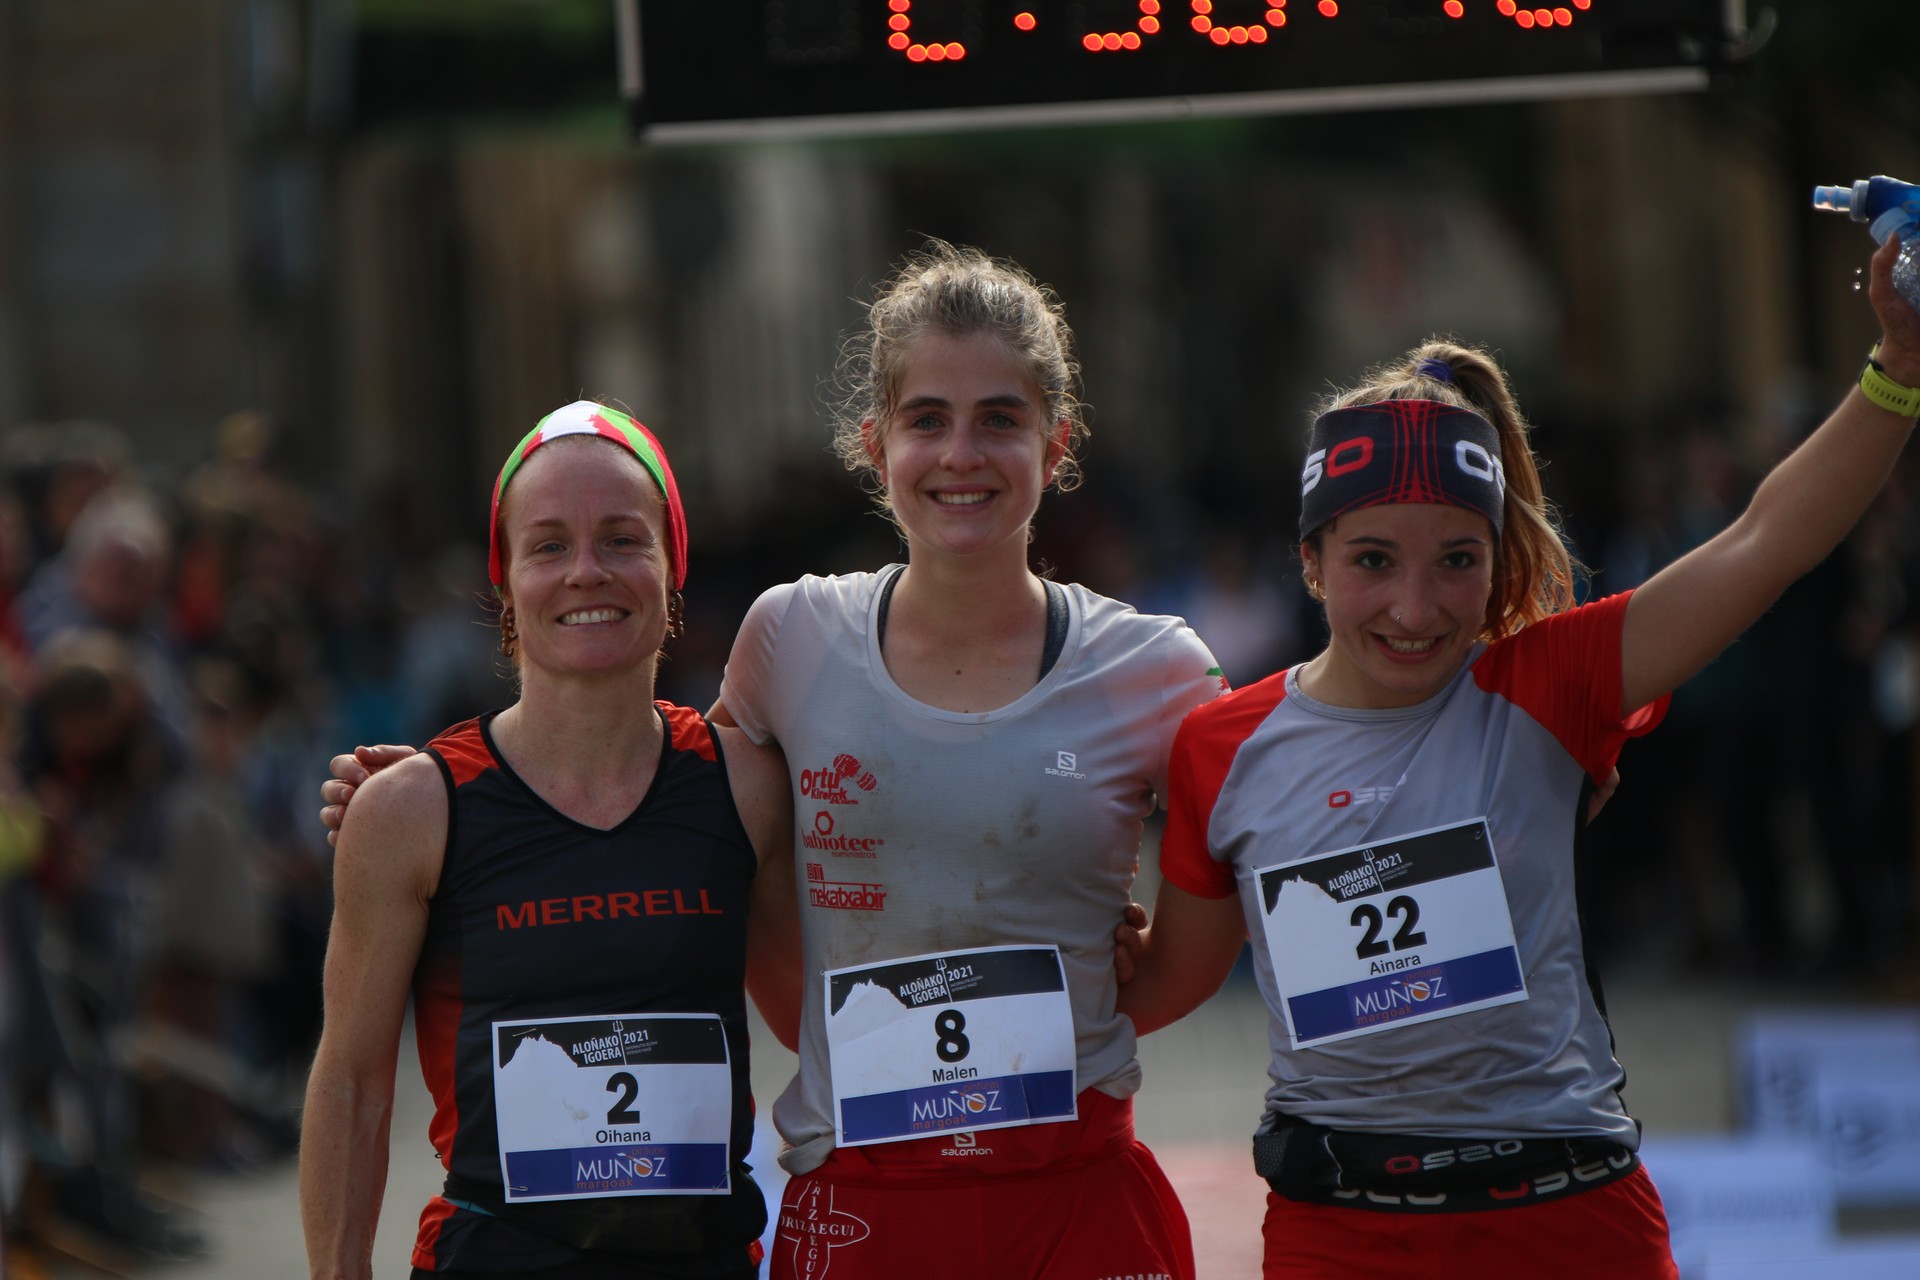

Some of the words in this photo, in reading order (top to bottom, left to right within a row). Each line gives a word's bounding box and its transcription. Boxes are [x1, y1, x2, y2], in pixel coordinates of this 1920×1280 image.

[800, 767, 841, 796] Ortu
[831, 851, 878, 859] suministros
[1328, 864, 1373, 892] ALOÑAKO
[1376, 853, 1404, 873] 2021
[1340, 876, 1378, 899] IGOERA
[496, 889, 724, 931] MERRELL
[1351, 895, 1428, 960] 22
[1370, 954, 1422, 975] Ainara
[1405, 966, 1442, 982] pinturas
[900, 973, 944, 998] ALOÑAKO
[947, 965, 974, 982] 2021
[911, 986, 948, 1006] IGOERA
[1355, 976, 1447, 1016] MUÑOZ
[1357, 1005, 1414, 1025] margoak
[572, 1035, 620, 1056] ALOÑAKO
[624, 1029, 649, 1045] 2021
[935, 1009, 971, 1063] 8
[584, 1047, 622, 1065] IGOERA
[932, 1067, 978, 1083] Malen
[963, 1081, 1000, 1093] pinturas
[606, 1072, 640, 1125] 2
[912, 1090, 1002, 1123] MUÑOZ
[913, 1115, 968, 1131] margoak
[595, 1129, 651, 1144] Oihana
[631, 1147, 667, 1156] pinturas
[941, 1148, 993, 1157] salomon
[577, 1154, 667, 1182] MUÑOZ
[576, 1180, 634, 1191] margoak
[779, 1215, 855, 1237] RIZAEGUI
